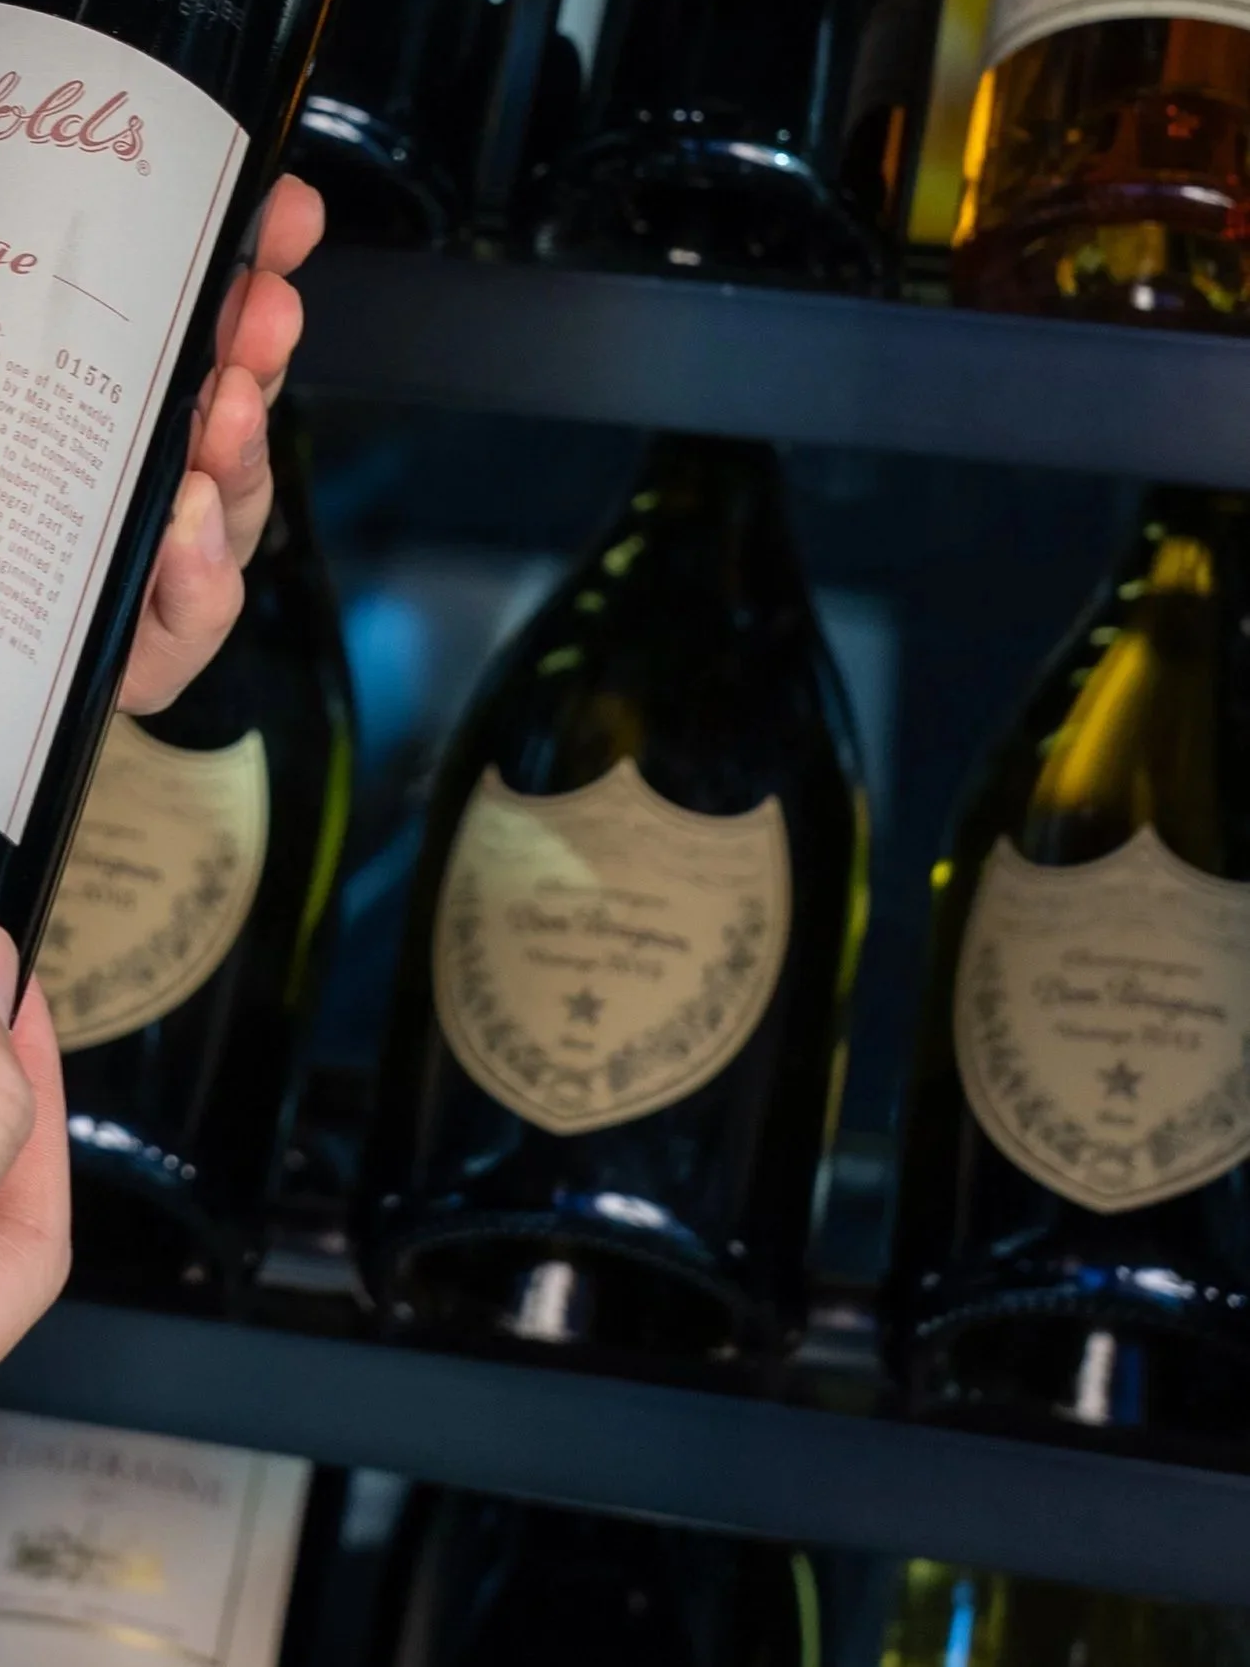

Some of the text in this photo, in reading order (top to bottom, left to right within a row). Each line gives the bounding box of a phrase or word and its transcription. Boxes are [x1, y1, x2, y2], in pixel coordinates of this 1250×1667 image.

[5, 360, 30, 379] one
[34, 374, 51, 389] of
[52, 381, 74, 404] the
[55, 348, 123, 404] 01576
[3, 377, 20, 397] by
[25, 388, 52, 413] Max
[2, 445, 17, 462] to
[12, 430, 38, 450] and
[8, 518, 56, 555] practice
[38, 513, 63, 536] part
[8, 542, 51, 574] untried
